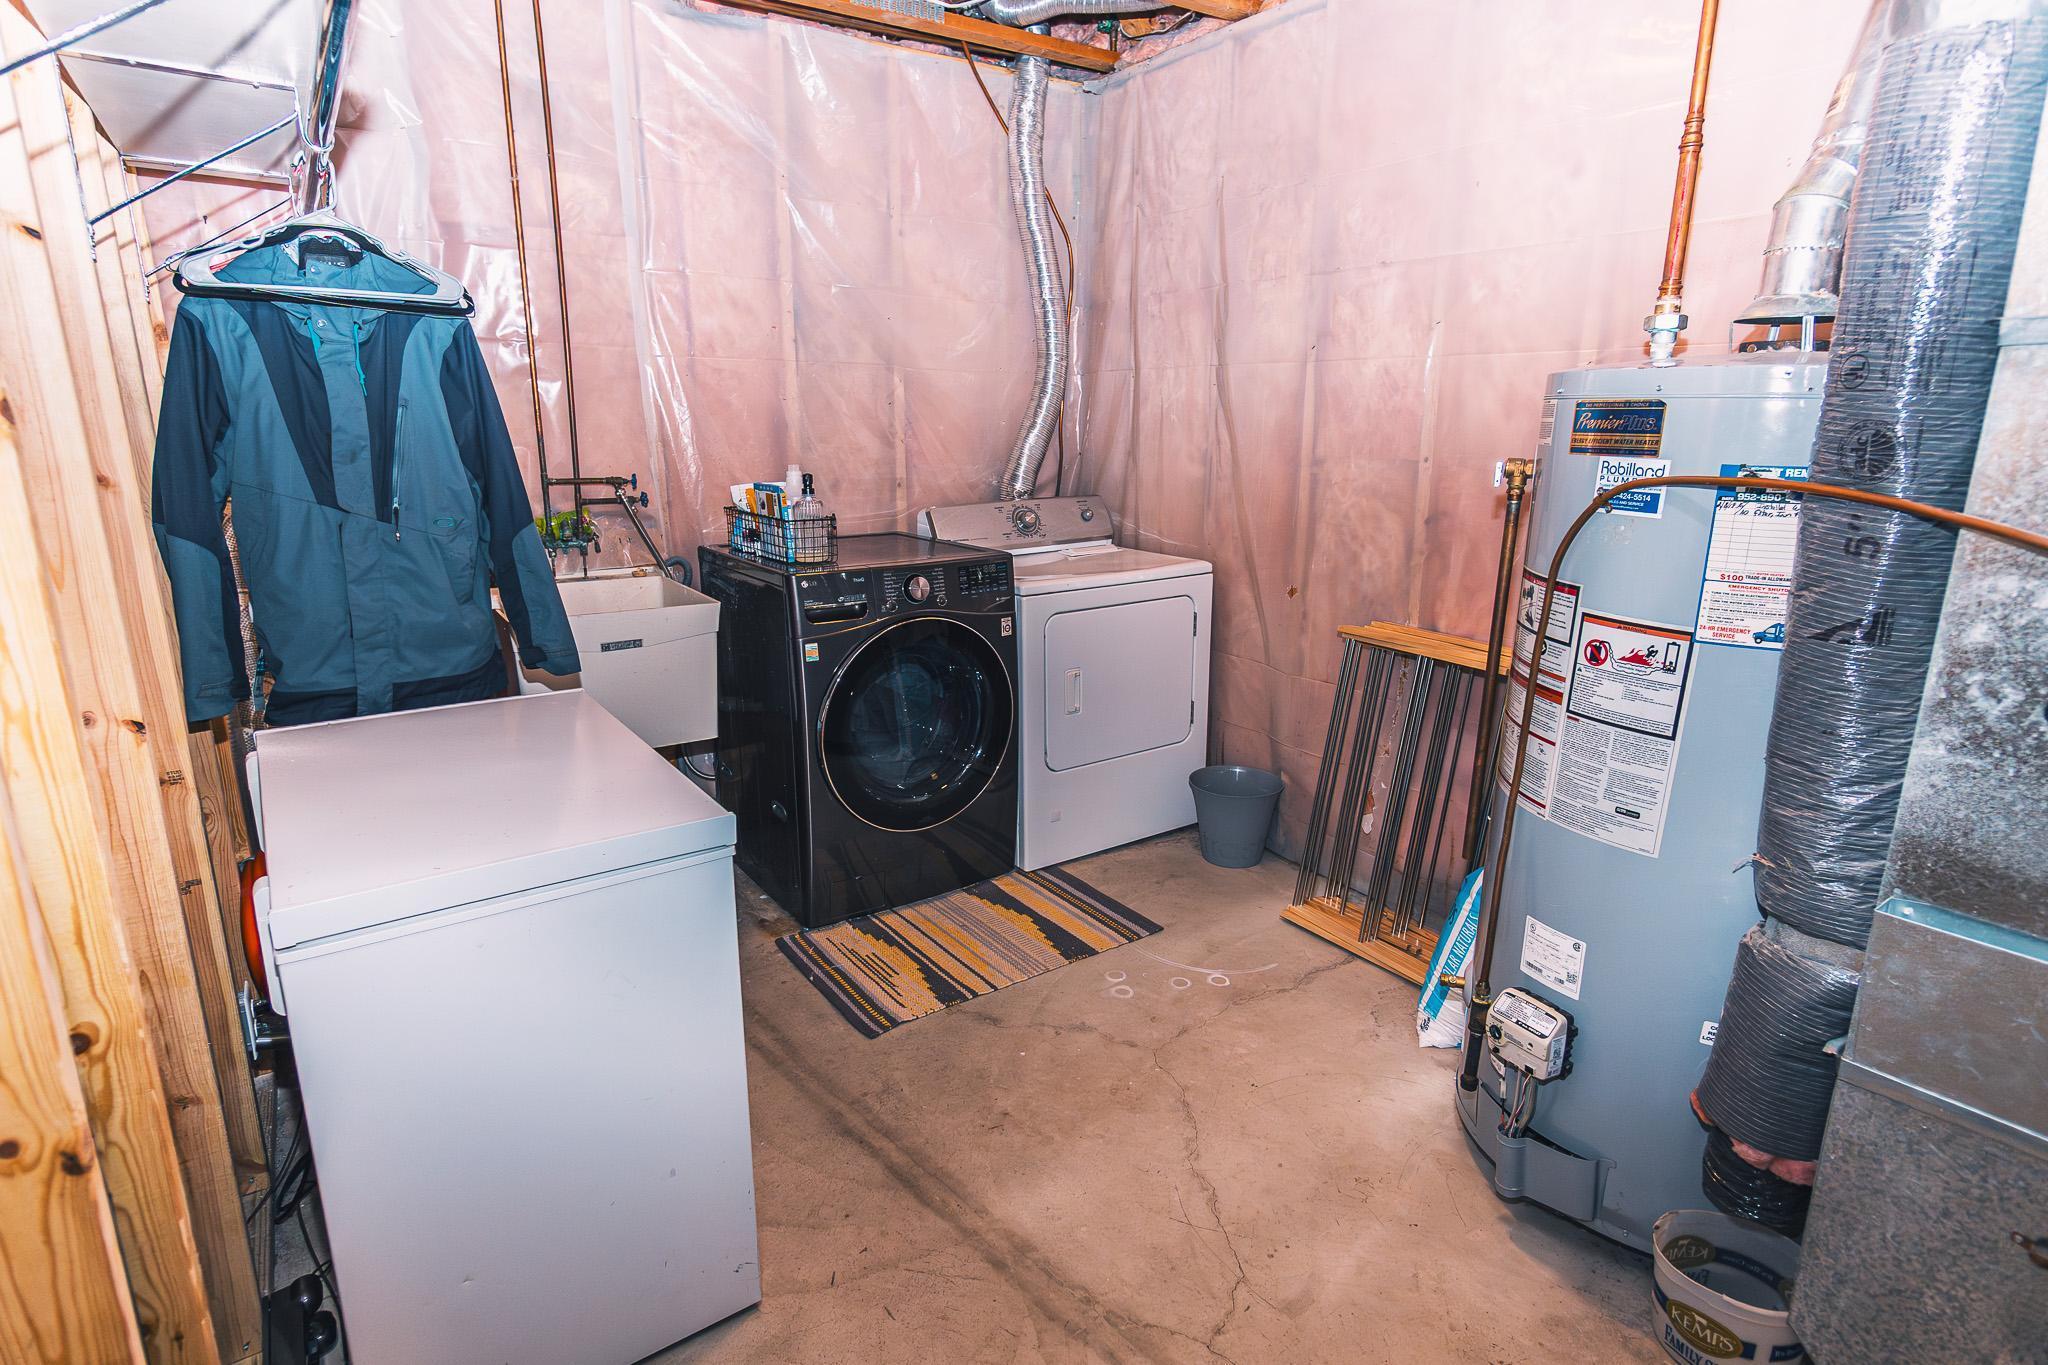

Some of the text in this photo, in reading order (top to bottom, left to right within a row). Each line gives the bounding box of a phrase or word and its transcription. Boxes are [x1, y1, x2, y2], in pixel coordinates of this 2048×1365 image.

[1613, 493, 1651, 501] -424-5514
[1737, 493, 1785, 501] 952-890-
[1720, 573, 1744, 582] $100
[1621, 625, 1647, 635] WARNING
[1716, 626, 1751, 635] EMERGENCY
[1712, 632, 1735, 640] SERVICE
[1671, 1305, 1734, 1352] KEMPS
[1664, 1323, 1703, 1365] FAMILY
